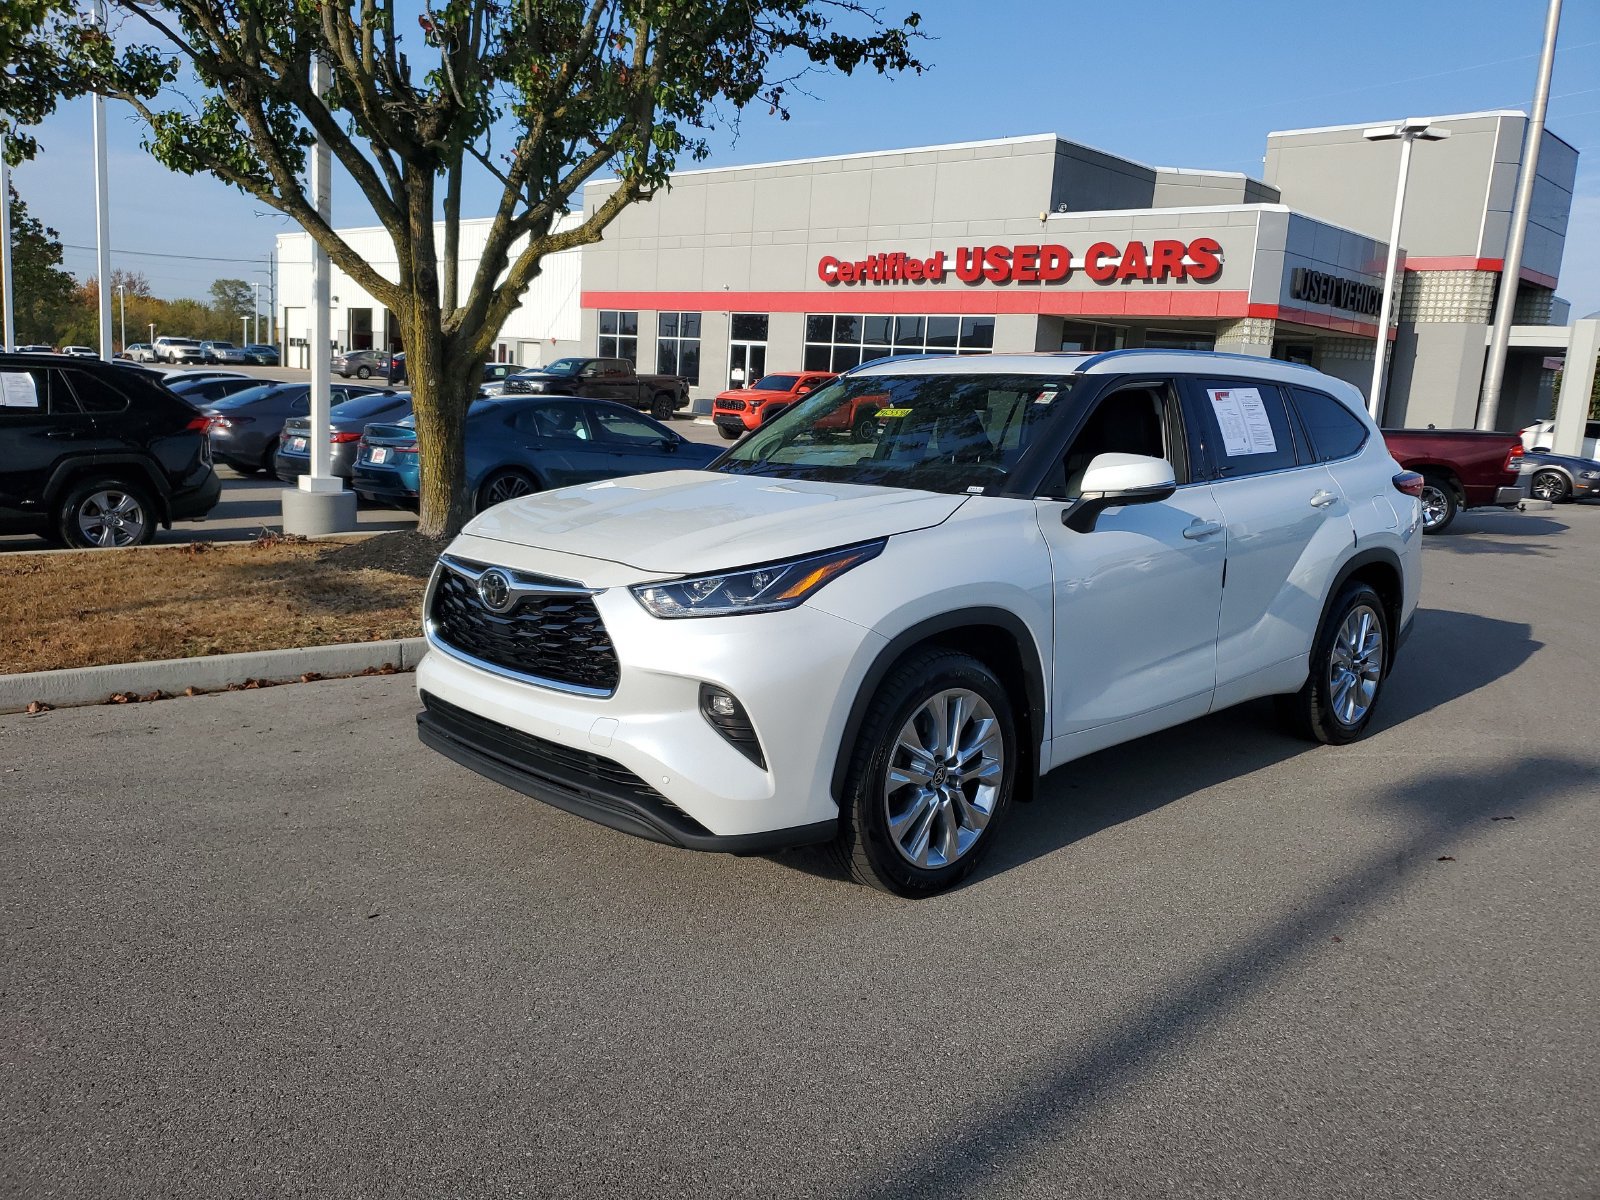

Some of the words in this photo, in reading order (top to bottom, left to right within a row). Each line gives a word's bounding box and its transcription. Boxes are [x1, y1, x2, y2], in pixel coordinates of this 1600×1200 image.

[818, 251, 944, 283] Certified
[956, 245, 1071, 282] USED
[1084, 237, 1220, 280] CARS
[1294, 268, 1337, 307] USED
[1340, 277, 1396, 319] VEHICL
